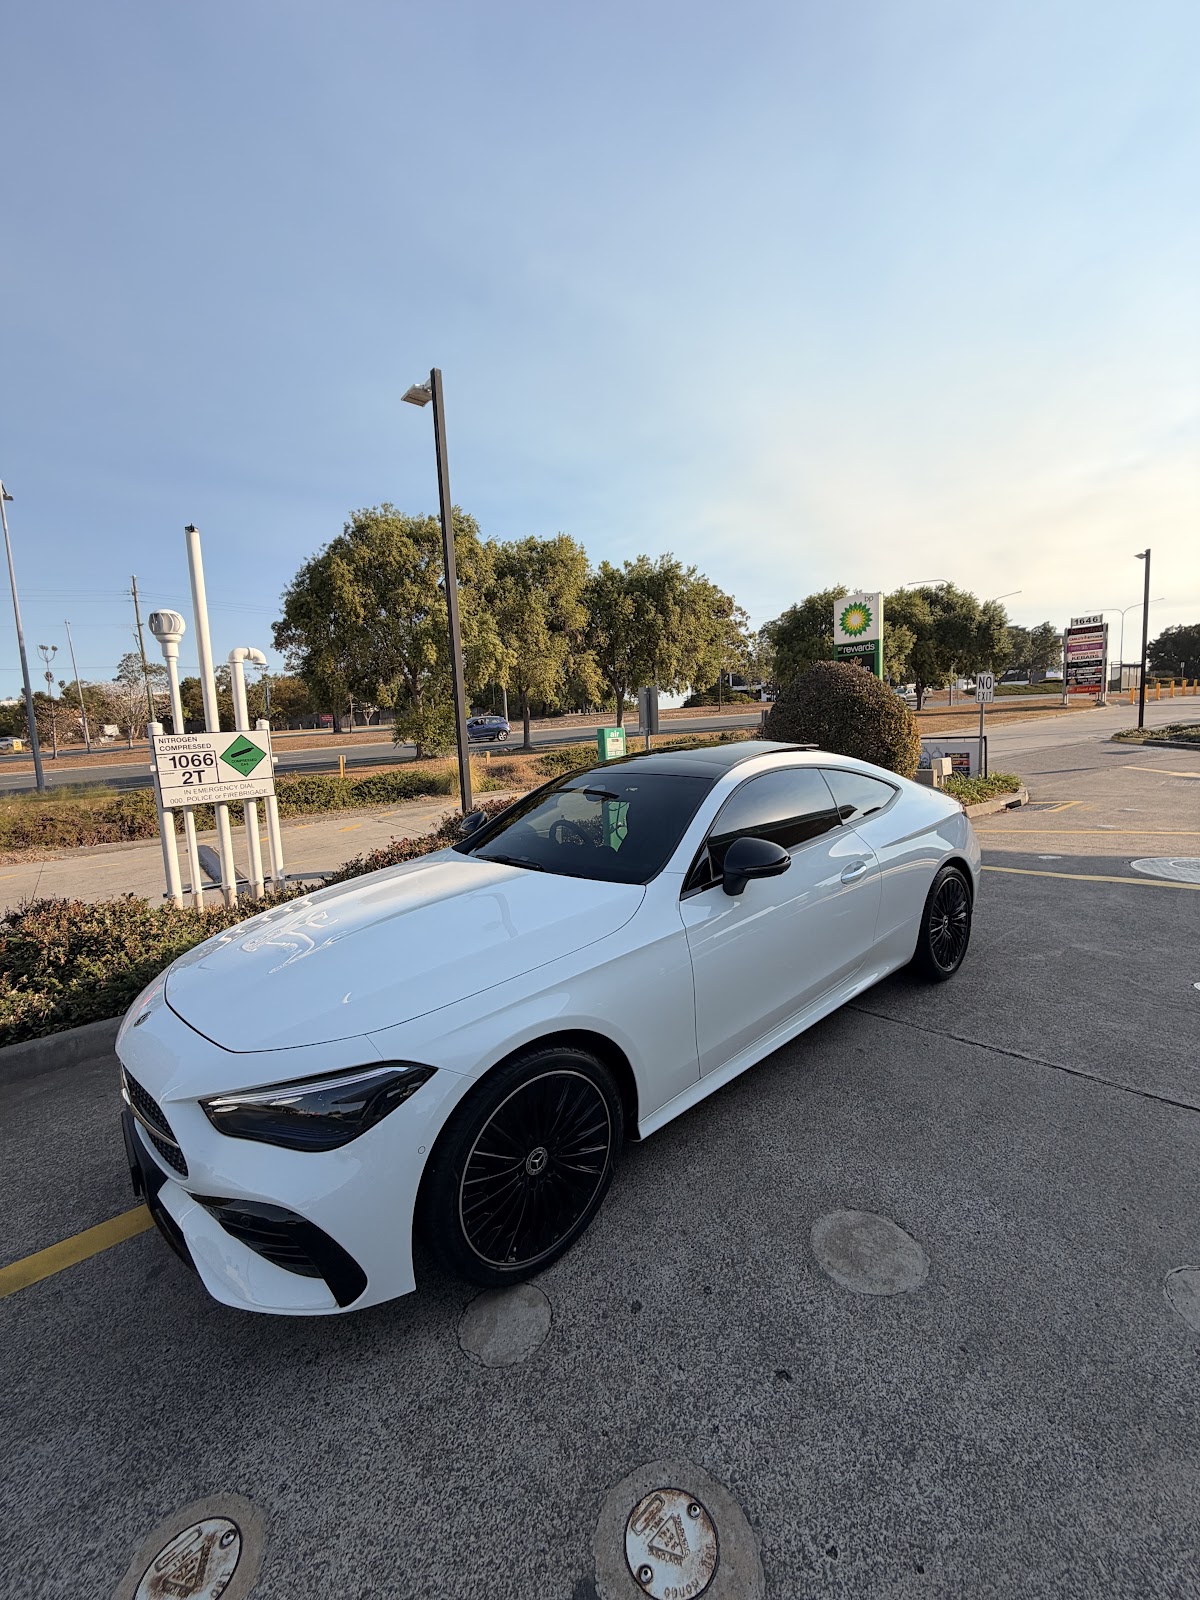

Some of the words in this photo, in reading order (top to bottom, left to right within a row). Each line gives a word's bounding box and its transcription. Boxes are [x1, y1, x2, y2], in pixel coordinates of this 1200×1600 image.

[1074, 616, 1098, 625] 1646
[843, 642, 875, 653] rewards
[978, 676, 992, 689] NO
[978, 692, 992, 701] EXIT
[158, 736, 198, 744] NITROGEN
[159, 743, 212, 752] COMPRESSED
[169, 753, 214, 769] 1066
[181, 770, 206, 785] 2T
[192, 784, 239, 795] EMERGENCY
[240, 782, 255, 790] DIAL
[186, 794, 214, 802] POLICE
[223, 788, 268, 799] FIREBRIGADE
